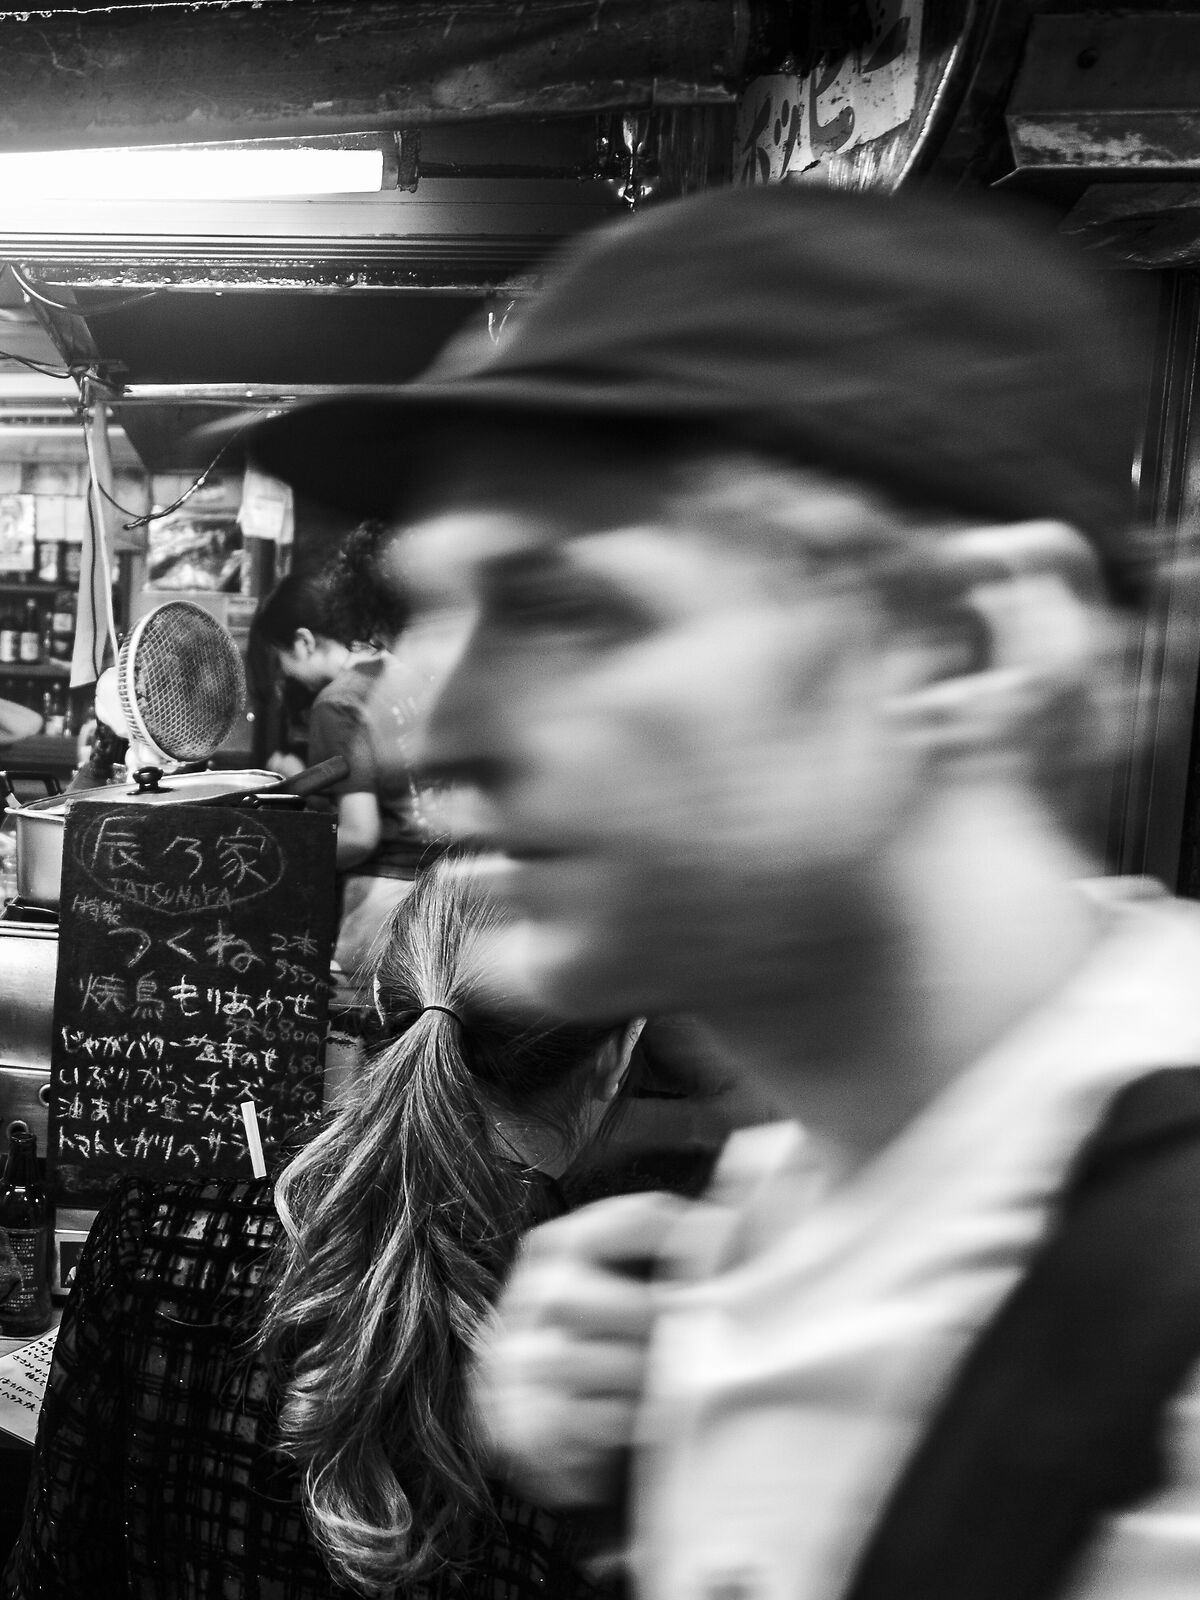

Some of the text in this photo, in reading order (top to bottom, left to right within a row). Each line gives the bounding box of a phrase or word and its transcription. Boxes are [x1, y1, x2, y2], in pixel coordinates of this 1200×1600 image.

[107, 919, 266, 974] つくね
[77, 969, 319, 1024] 焼鳥もりあわせ
